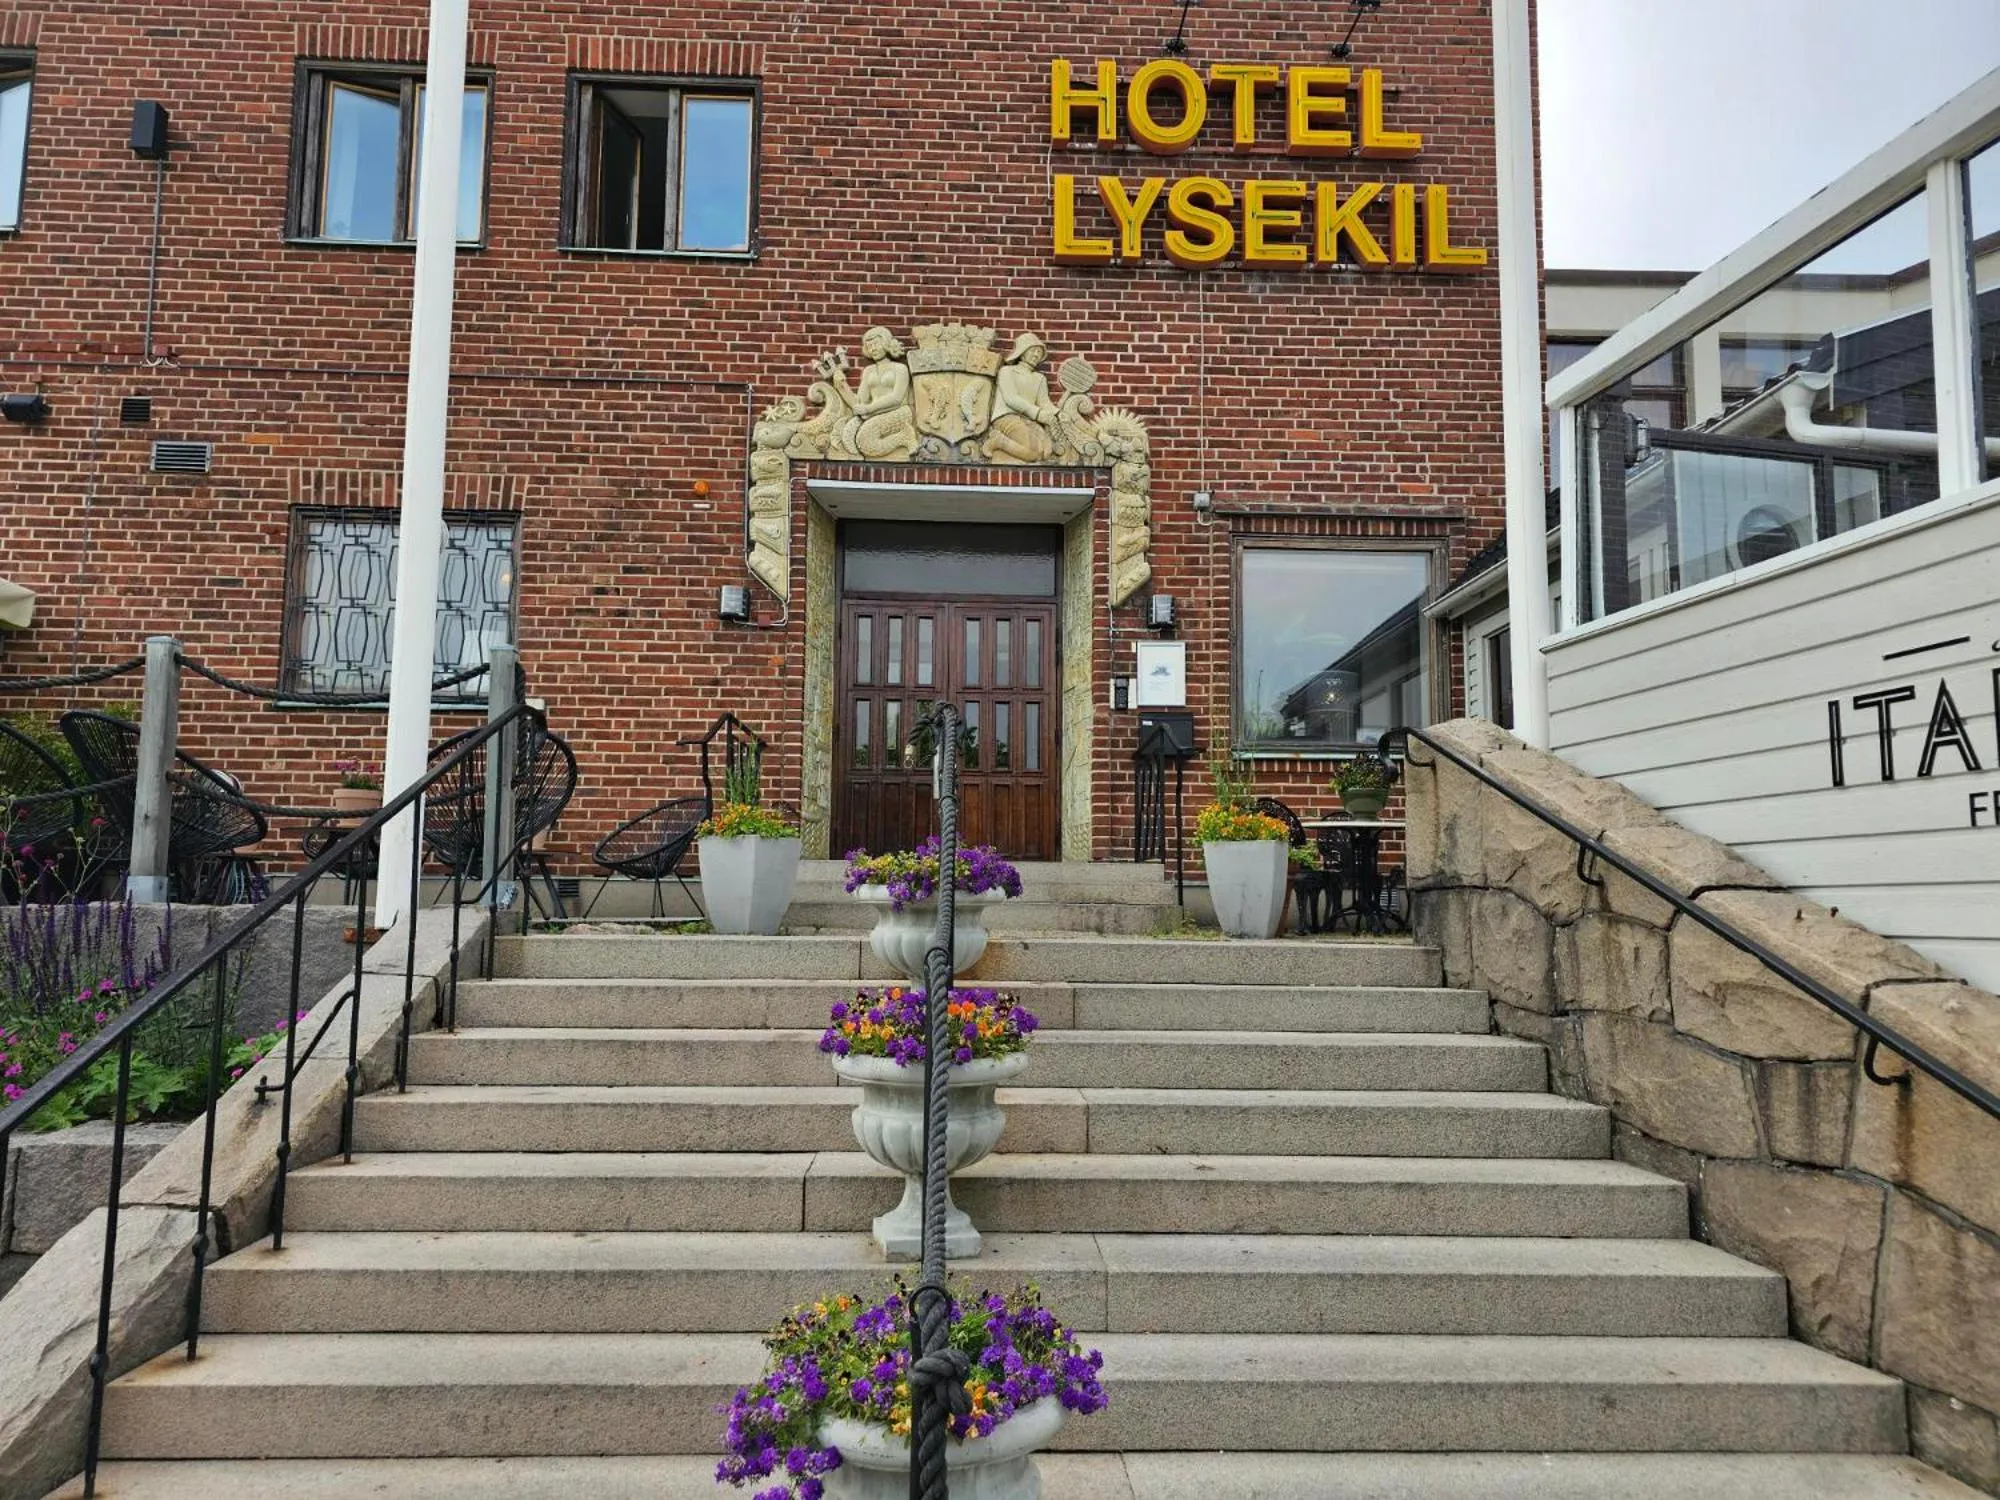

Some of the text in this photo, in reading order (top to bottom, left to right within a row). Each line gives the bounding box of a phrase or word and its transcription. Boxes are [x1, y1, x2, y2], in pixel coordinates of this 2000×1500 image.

[1051, 59, 1422, 158] HOTEL
[1053, 174, 1488, 272] LYSEKIL
[1828, 668, 2000, 787] ITA
